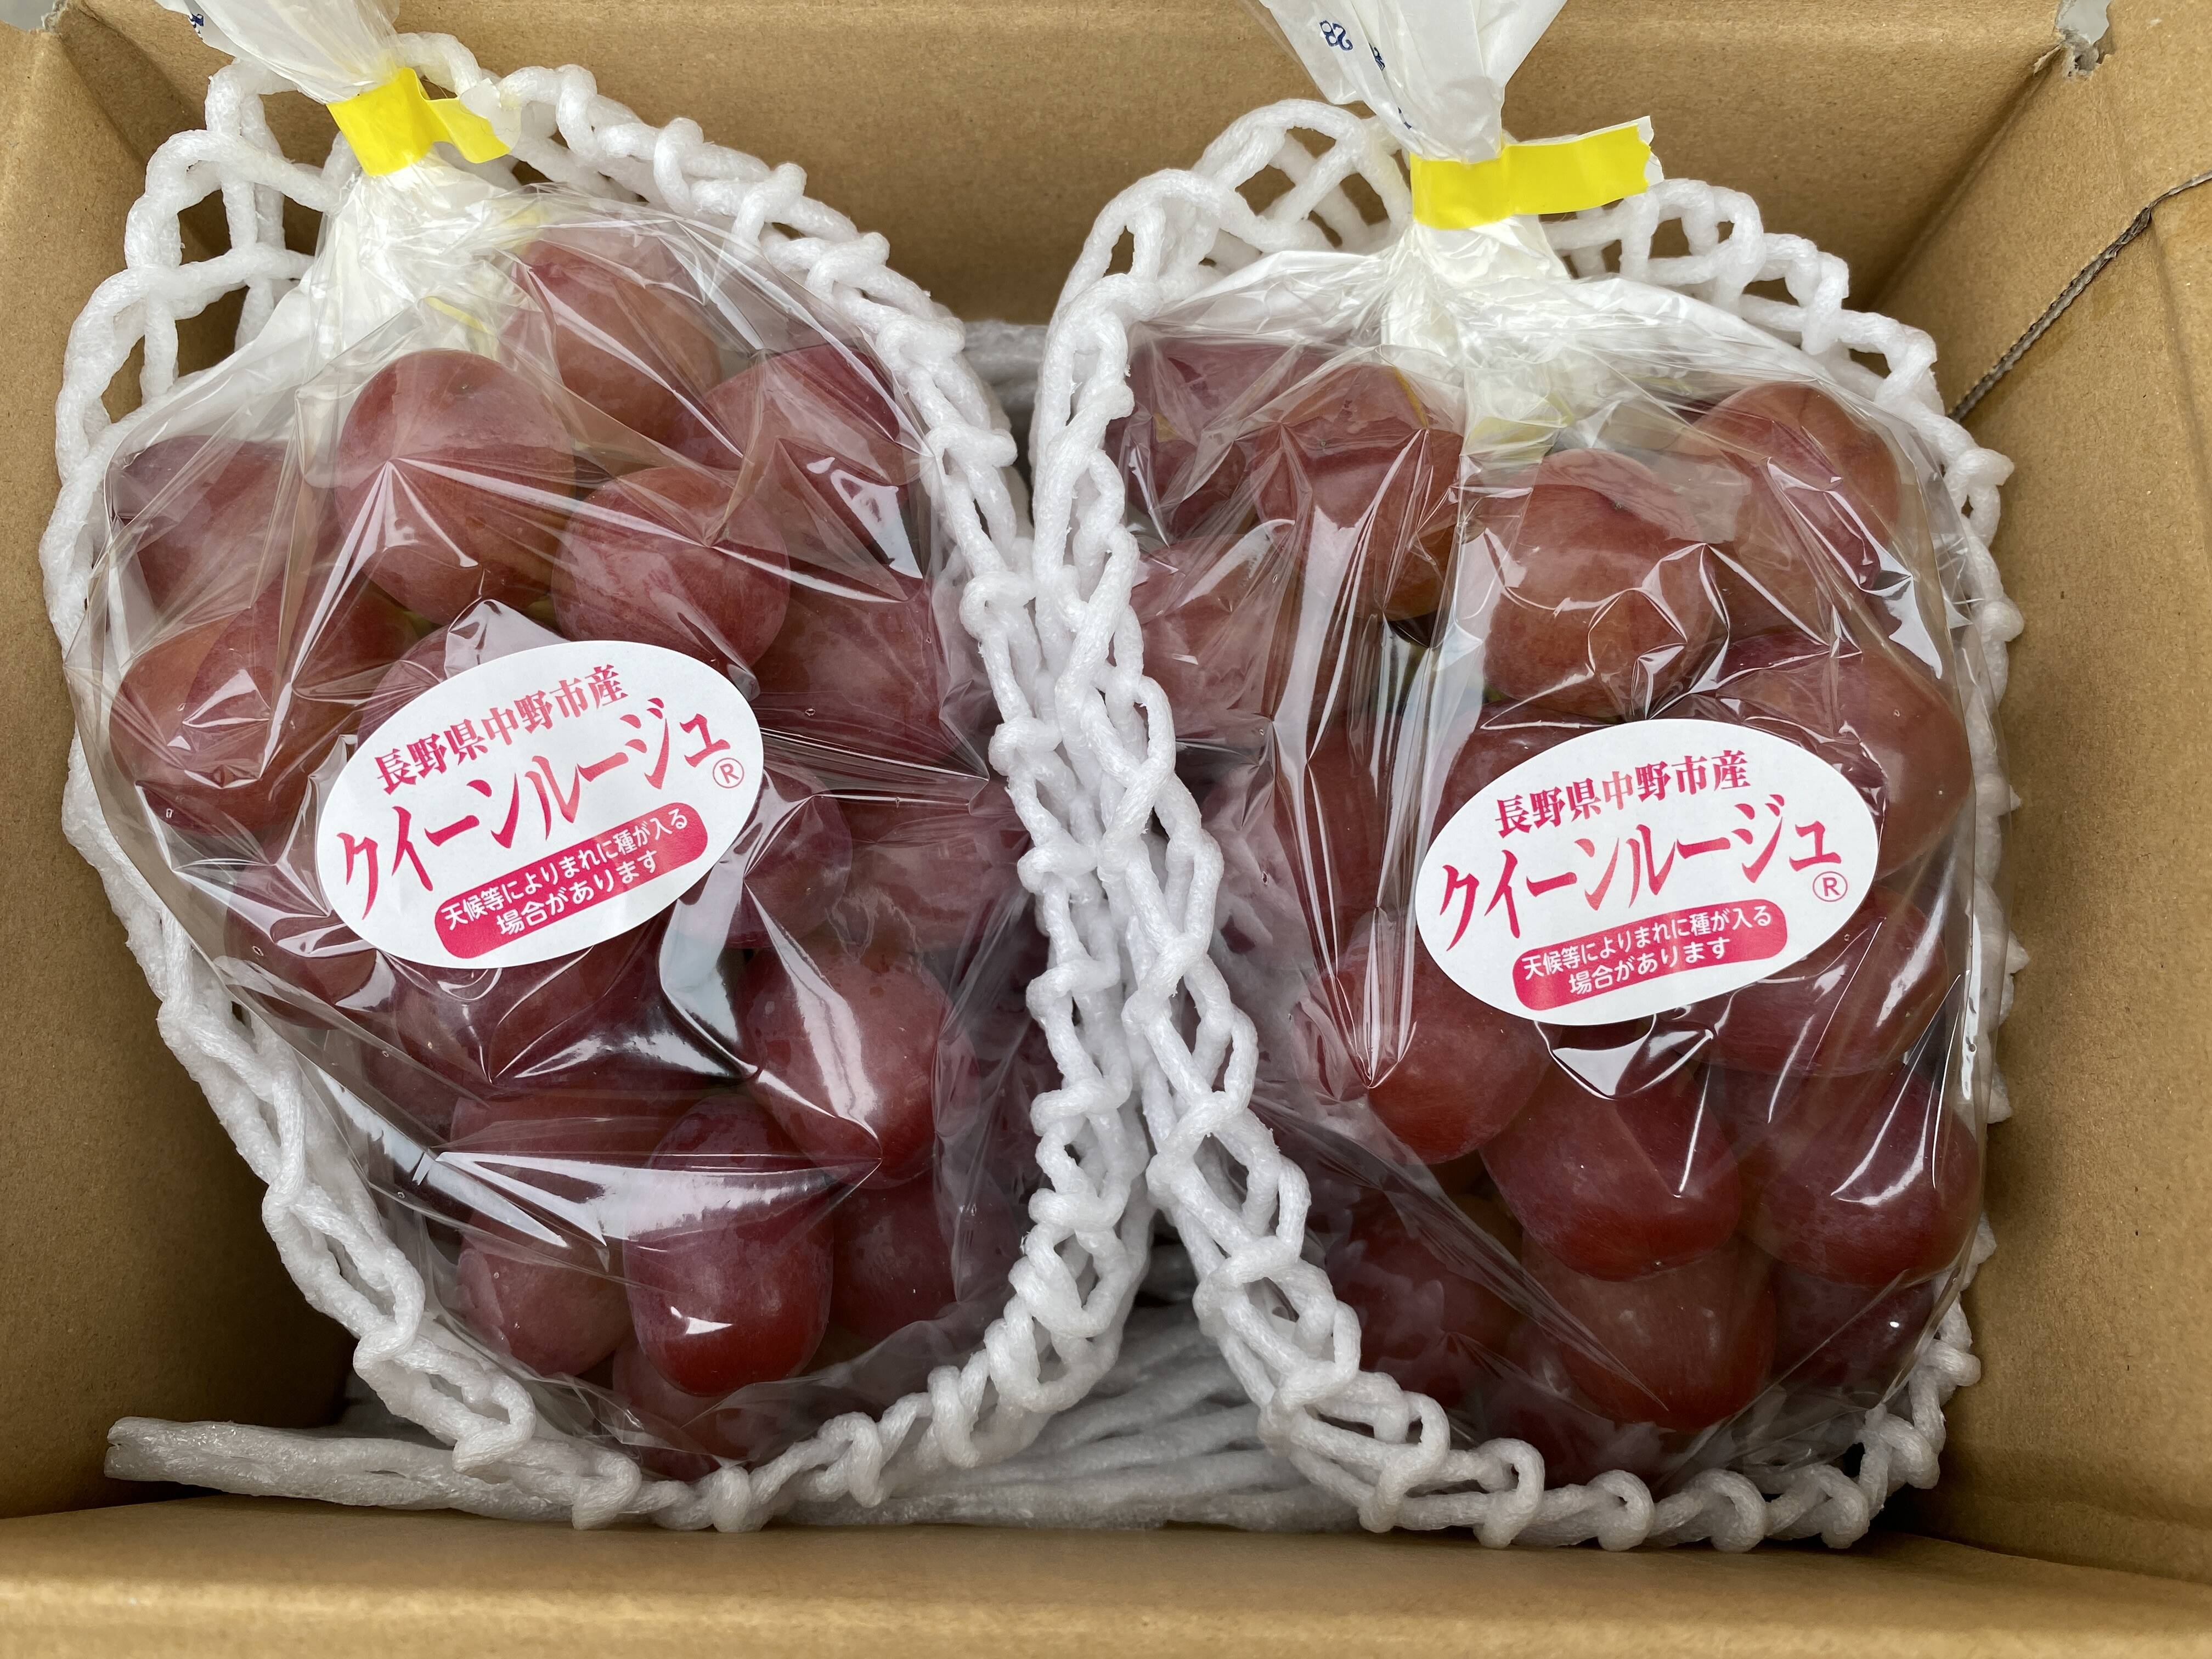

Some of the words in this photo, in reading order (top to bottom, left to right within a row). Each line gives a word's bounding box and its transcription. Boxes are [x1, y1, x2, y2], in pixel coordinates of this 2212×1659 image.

[375, 663, 629, 795] 長野県中野市産
[336, 697, 731, 919] クイーンルージュ
[1495, 749, 1751, 839] 長野県中野市産
[441, 808, 688, 931] 天候等によりまれに種が入る
[496, 849, 658, 935] 場合があります
[1440, 793, 1842, 952] クイーンルージュ
[1521, 905, 1771, 981] 天候等によりまれに種が入る
[1568, 936, 1730, 995] 場合があります
